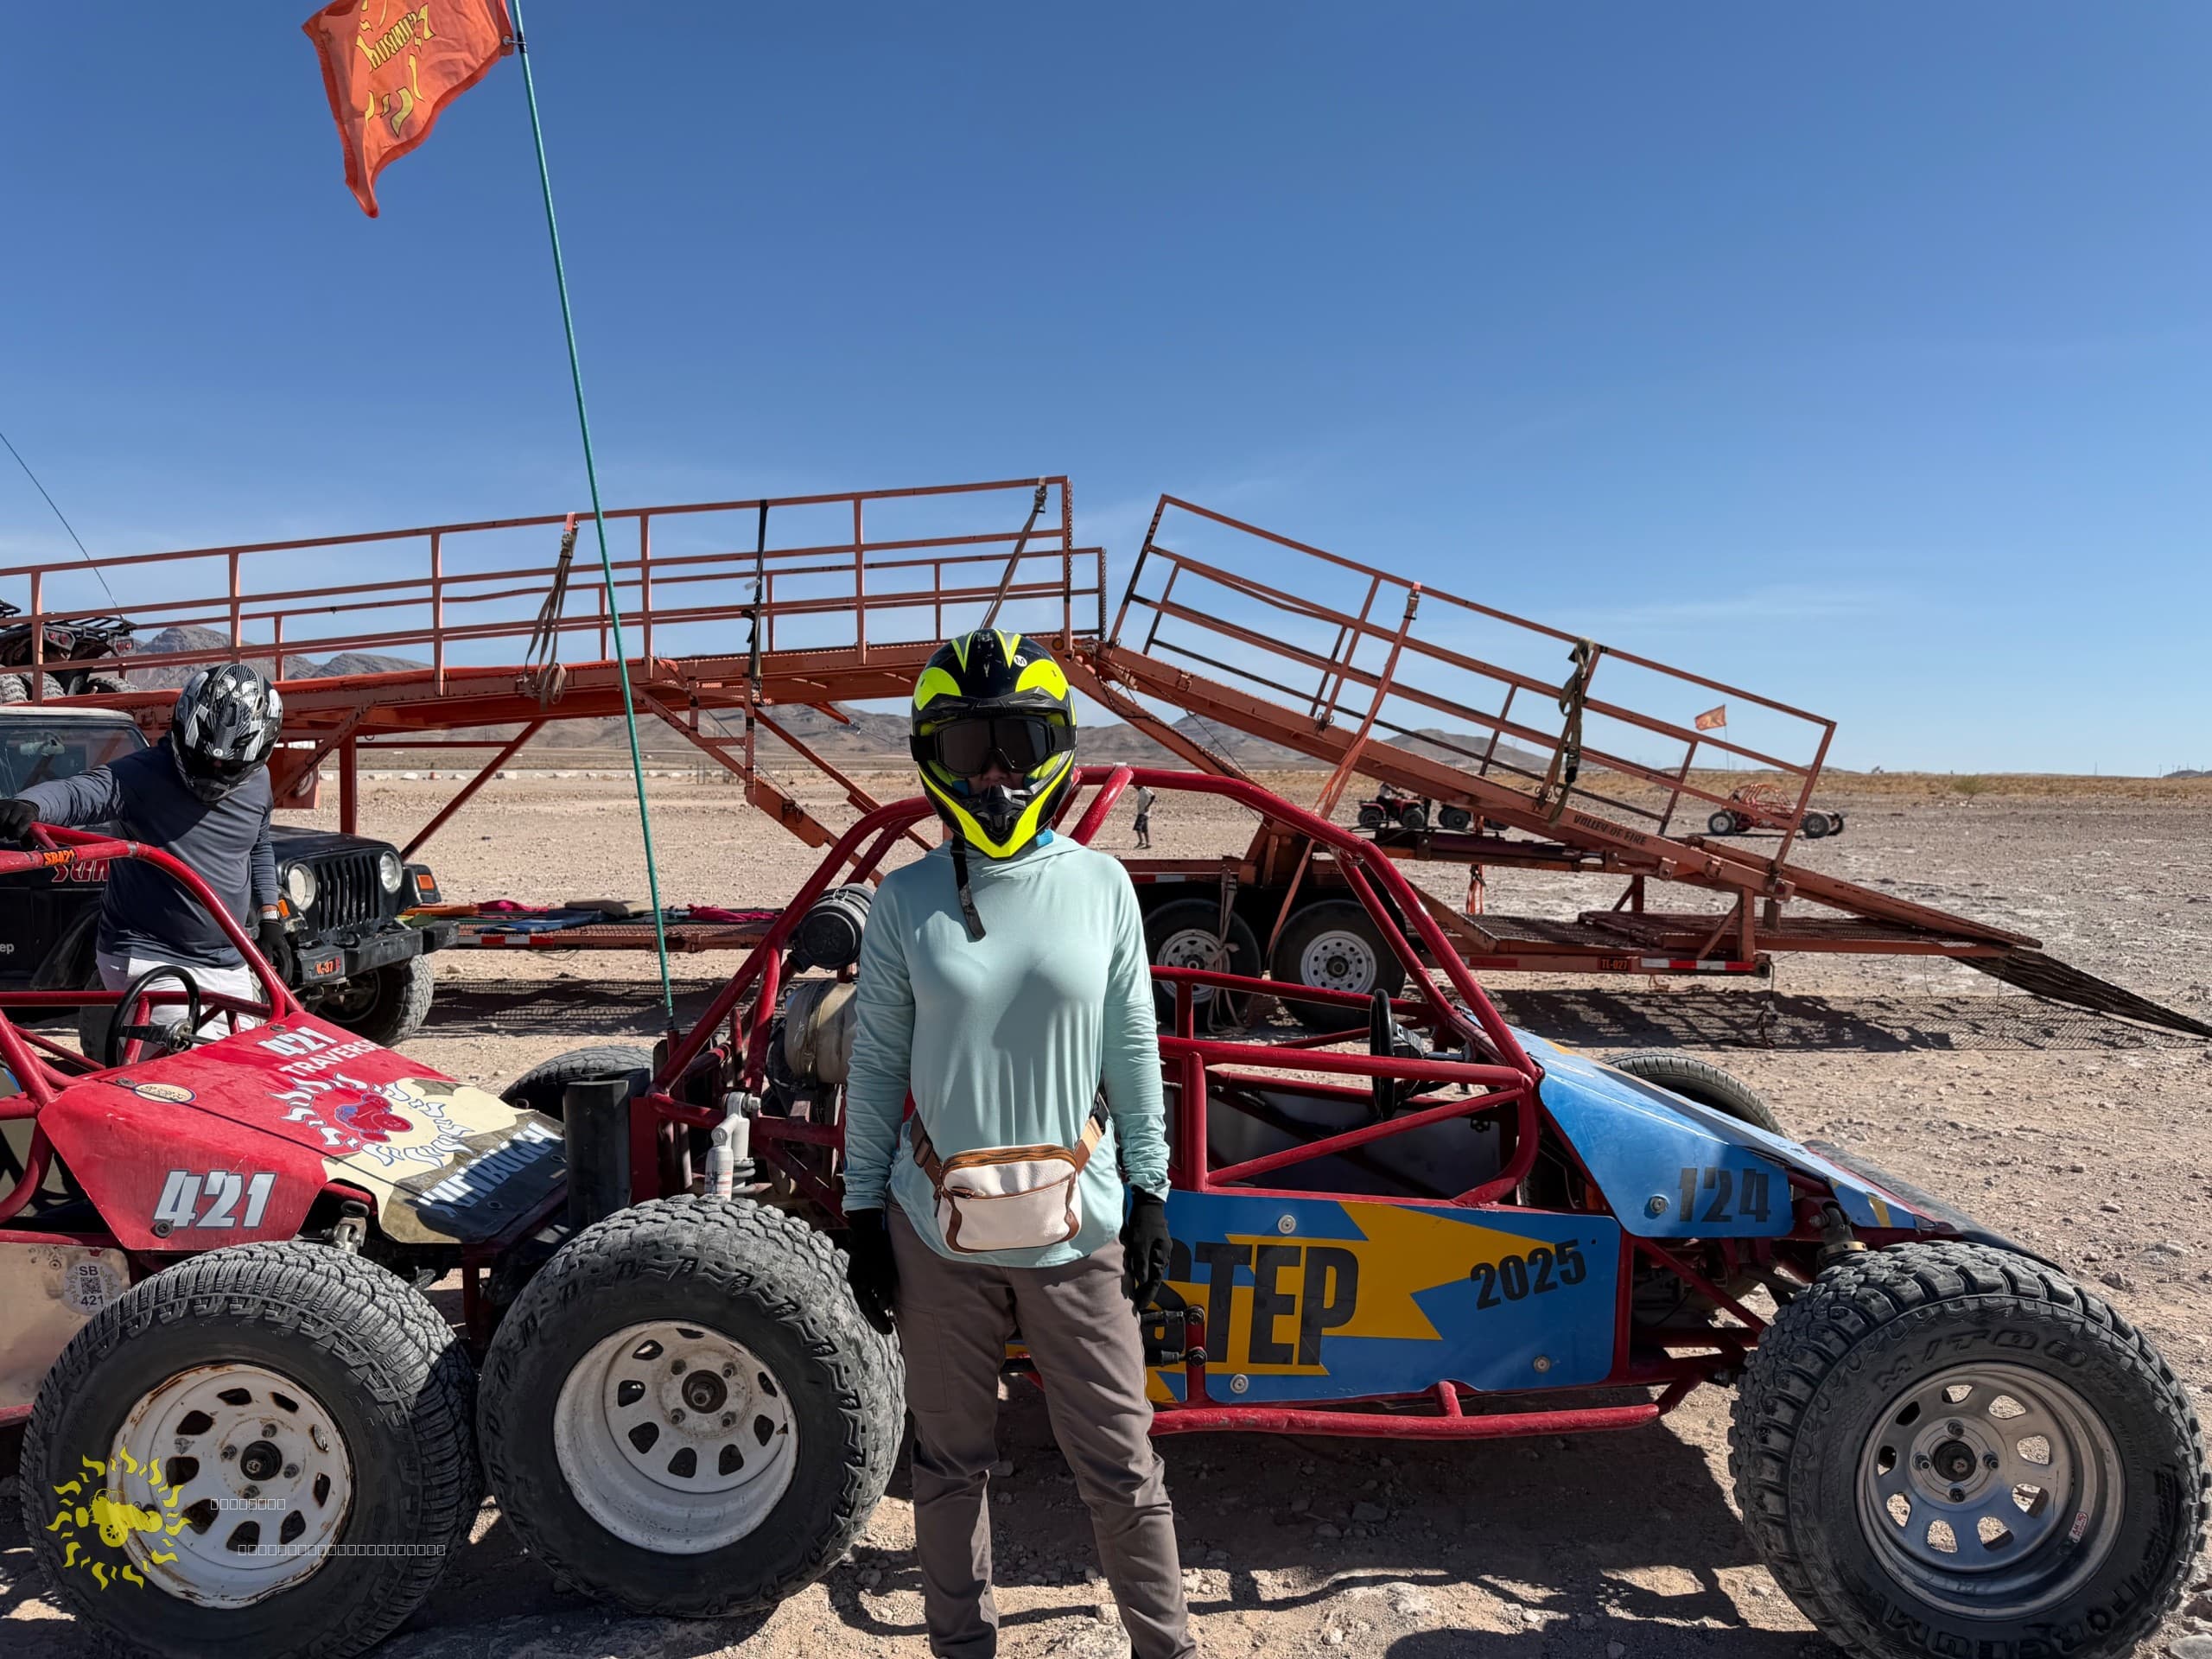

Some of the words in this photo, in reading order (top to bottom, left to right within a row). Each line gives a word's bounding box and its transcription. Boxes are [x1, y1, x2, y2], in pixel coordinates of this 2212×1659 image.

[1573, 815, 1608, 832] VALLEY
[1610, 827, 1624, 838] OF
[1624, 830, 1647, 845] FIRE
[257, 1027, 338, 1056] 421
[154, 1169, 276, 1229] 421
[1679, 1167, 1770, 1223] 124
[79, 1266, 99, 1276] SB
[1471, 1238, 1586, 1310] 2025
[81, 1294, 104, 1306] 421
